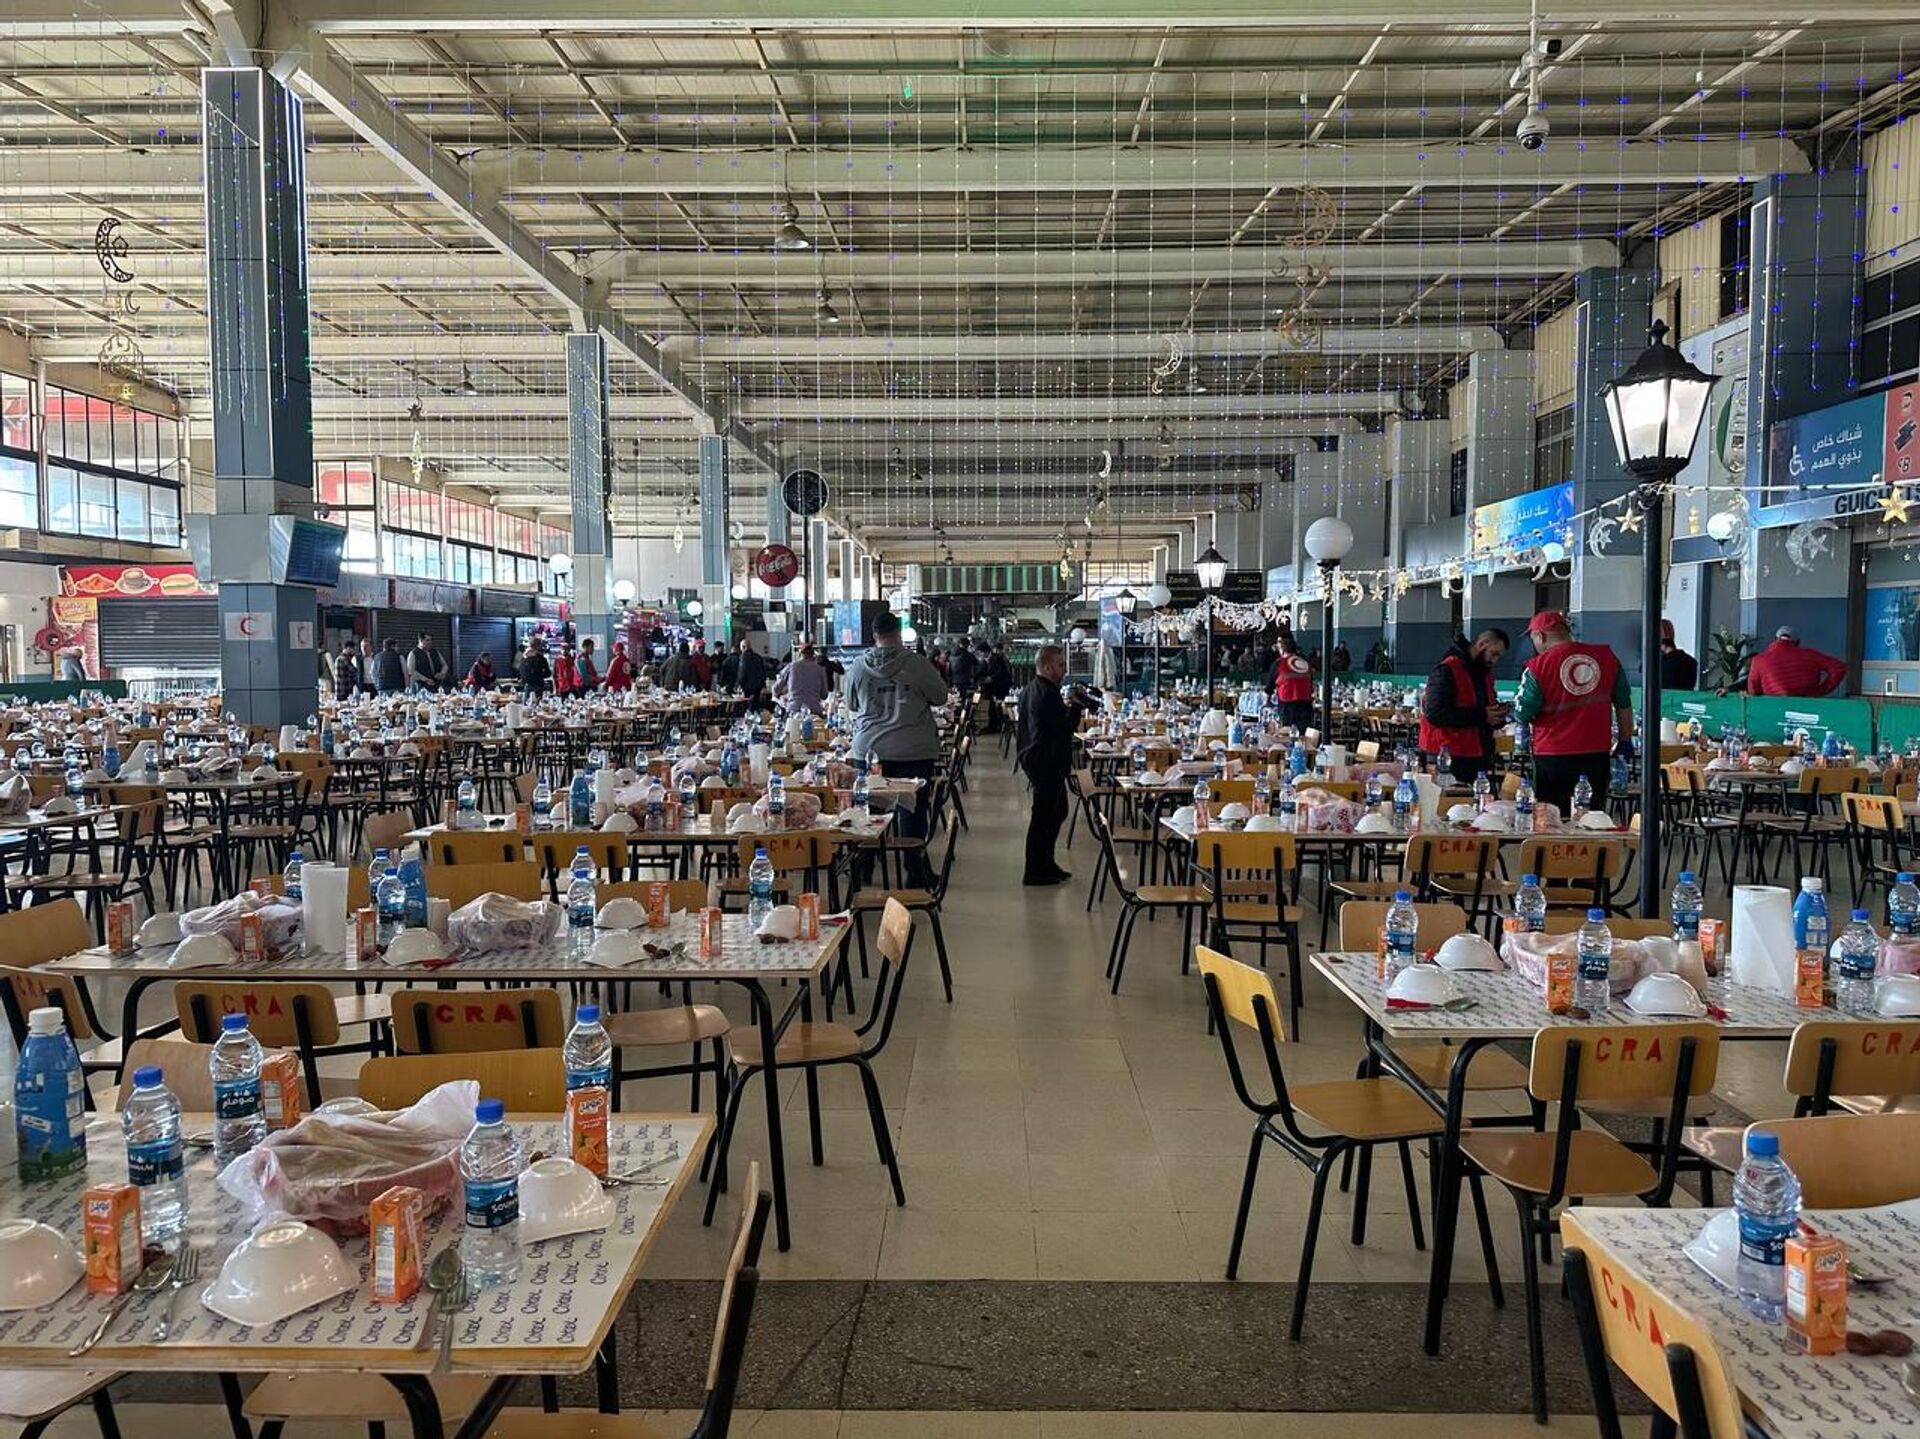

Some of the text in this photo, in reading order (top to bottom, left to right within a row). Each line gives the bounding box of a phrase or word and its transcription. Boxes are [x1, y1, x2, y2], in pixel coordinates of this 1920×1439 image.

[1812, 424, 1862, 453] شباك خاص
[1439, 839, 1477, 853] CRA
[1552, 843, 1589, 857] CRA
[222, 994, 284, 1017] CRA
[436, 1003, 517, 1024] CRA
[1595, 1036, 1663, 1062] CRA
[1601, 1267, 1664, 1347] CRA
